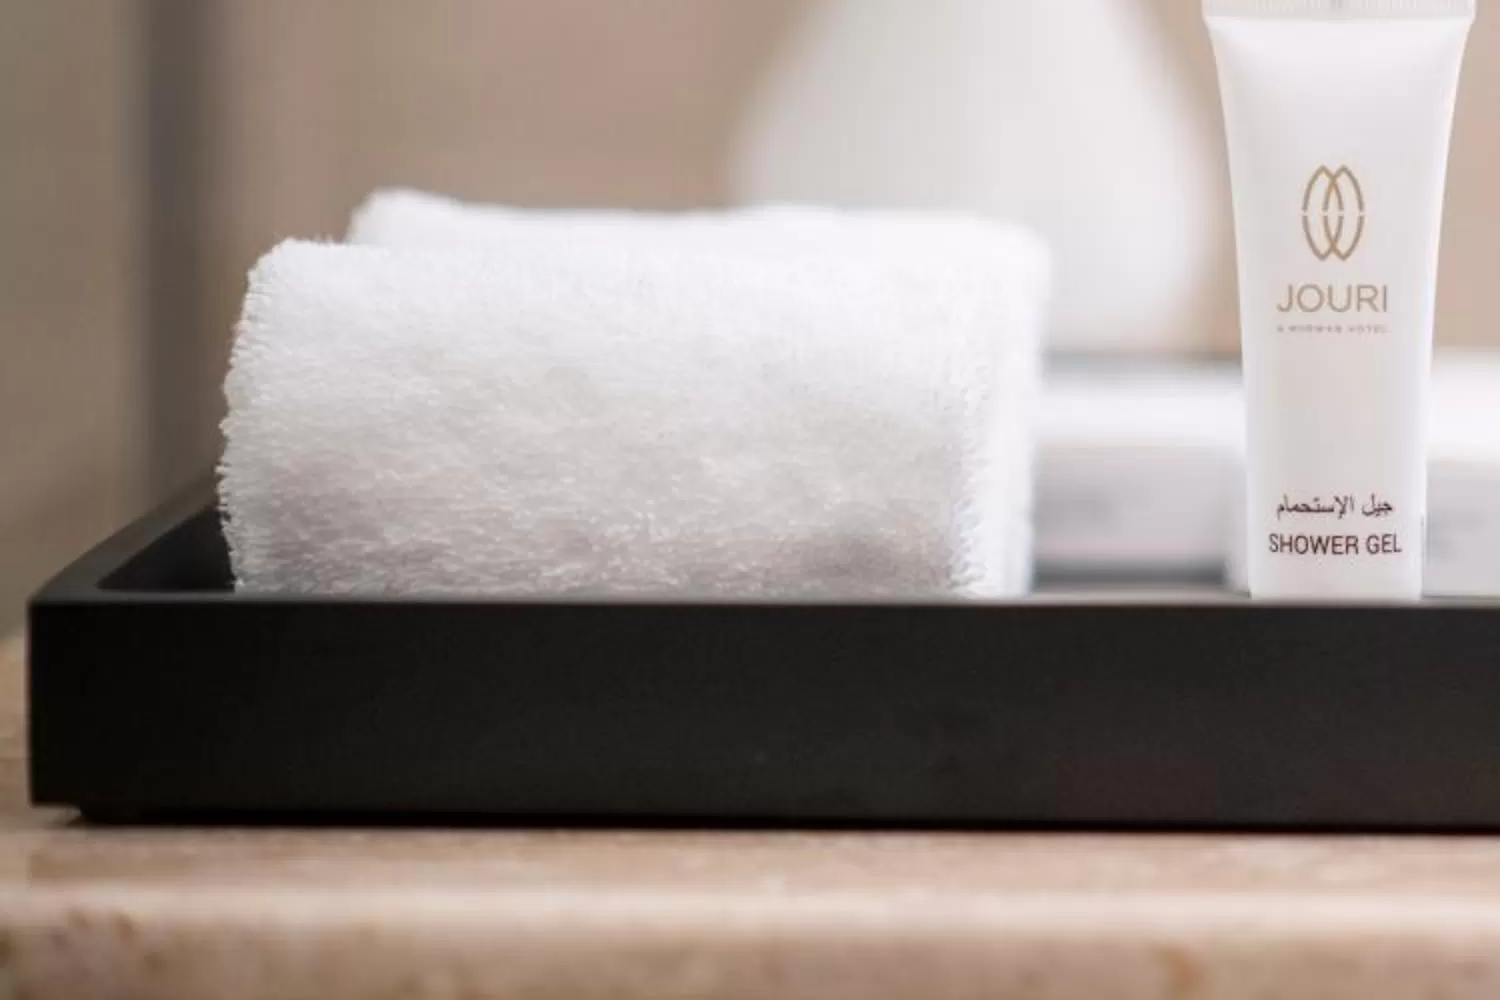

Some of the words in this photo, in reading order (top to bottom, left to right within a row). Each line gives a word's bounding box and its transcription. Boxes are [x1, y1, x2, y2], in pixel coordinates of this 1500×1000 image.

[1275, 283, 1388, 313] JOURI
[1362, 492, 1395, 519] جيل
[1268, 532, 1360, 556] SHOWER
[1365, 533, 1403, 556] GEL
